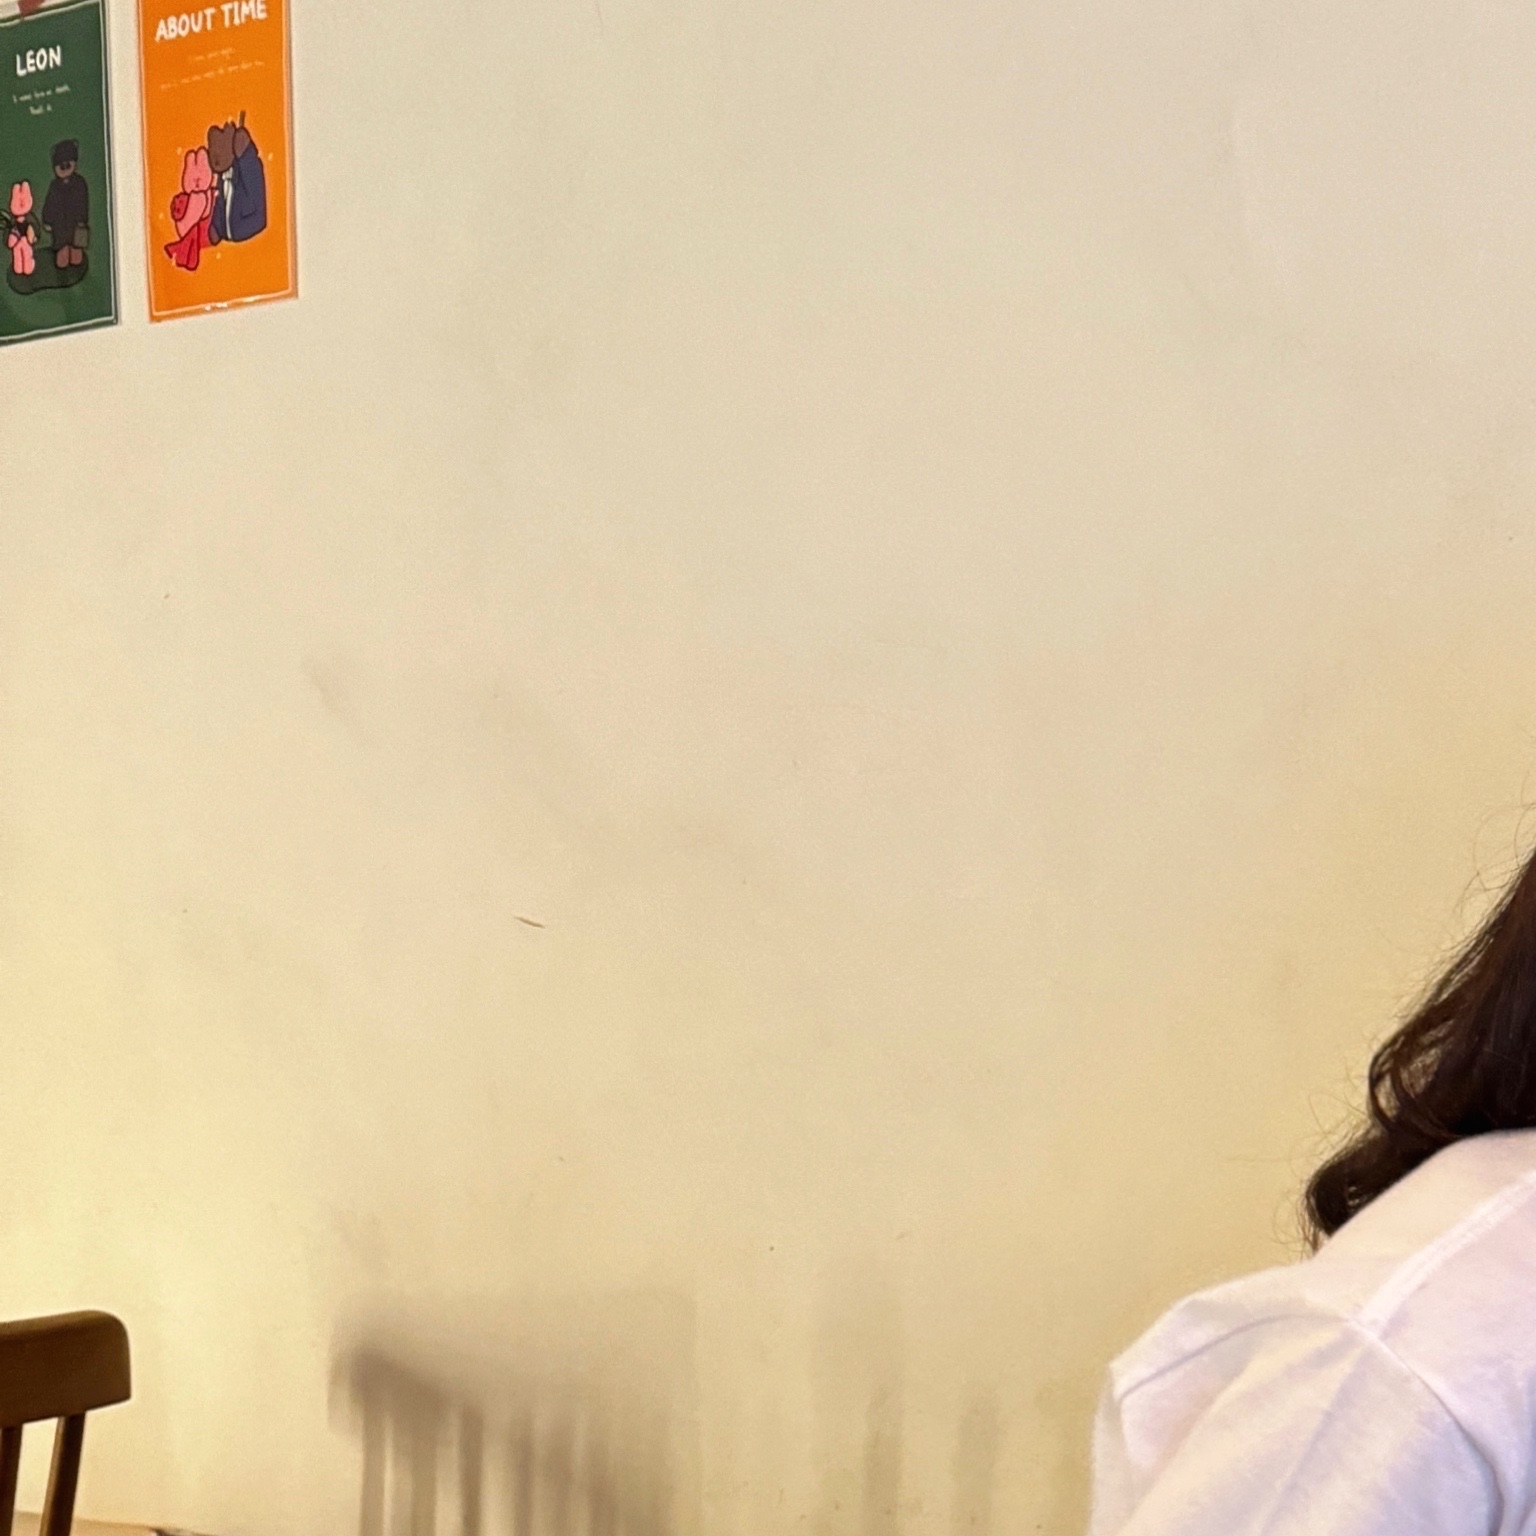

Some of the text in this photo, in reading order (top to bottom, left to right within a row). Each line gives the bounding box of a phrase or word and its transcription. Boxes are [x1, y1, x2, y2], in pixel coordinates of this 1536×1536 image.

[155, 0, 268, 42] ABOUT TIME
[16, 44, 62, 77] LEON
